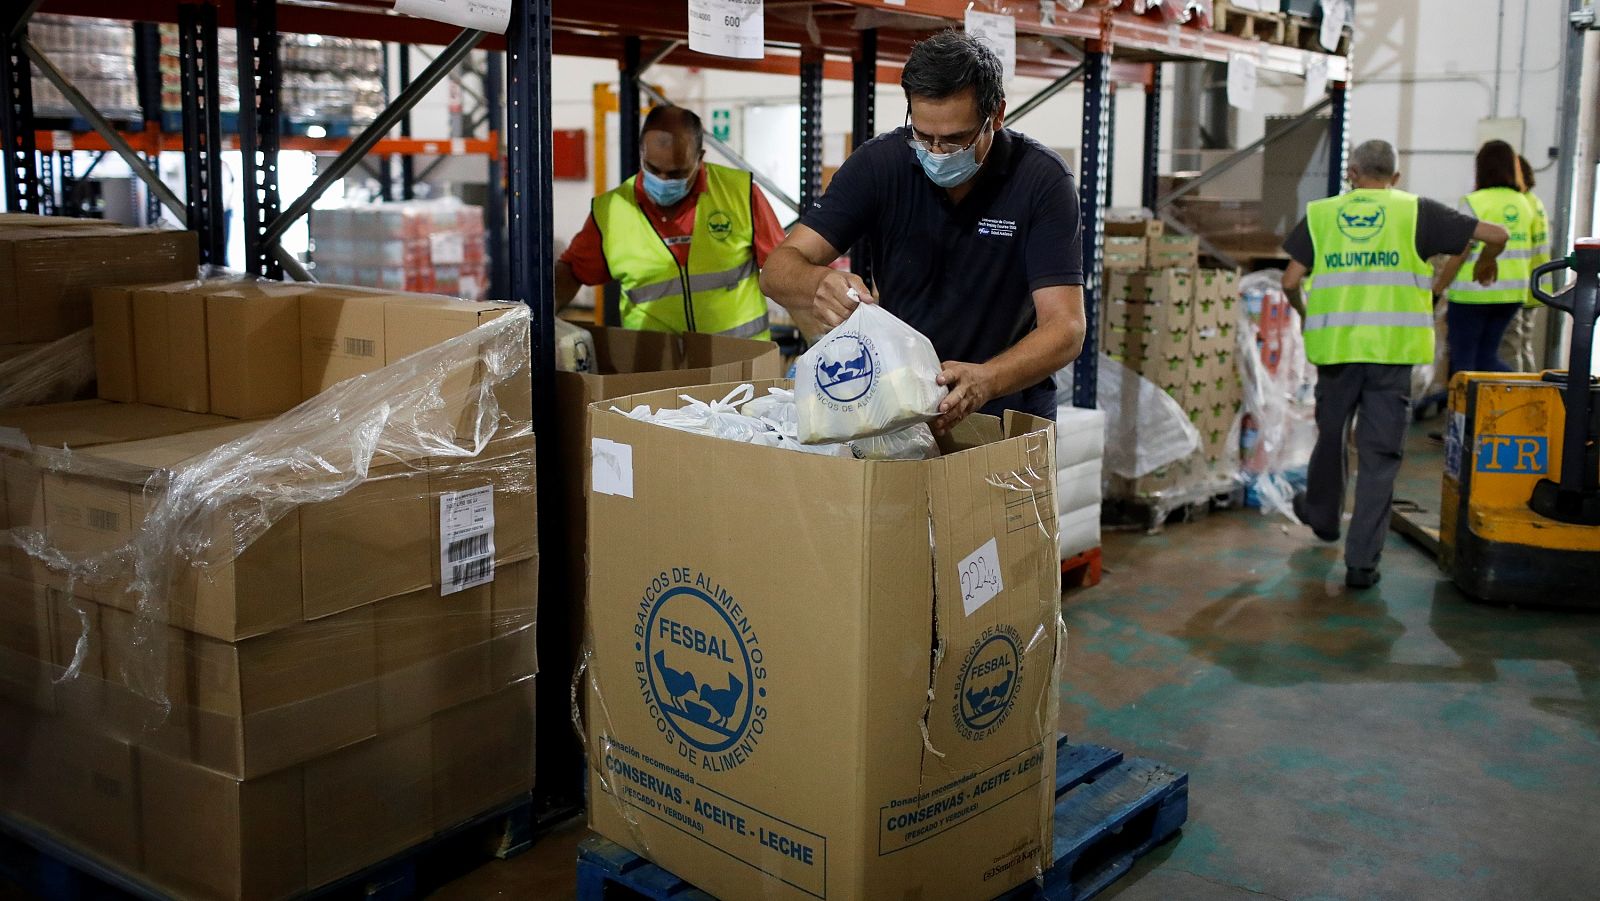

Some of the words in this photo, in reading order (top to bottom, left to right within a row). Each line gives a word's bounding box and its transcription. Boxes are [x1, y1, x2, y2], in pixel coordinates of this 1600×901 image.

[724, 15, 740, 28] 600
[1325, 251, 1399, 268] VOLUNTARIO
[842, 404, 854, 413] DE
[1481, 437, 1542, 471] TR
[635, 571, 670, 637] BANCOS
[672, 567, 691, 584] DE
[696, 572, 767, 680] ALIMENTOS
[659, 617, 734, 664] FESBAL
[954, 638, 981, 691] BANCOS
[982, 626, 994, 641] DE
[995, 623, 1025, 663] ALIMENTOS
[971, 653, 1011, 681] FESBAL
[635, 661, 675, 745] BANCOS
[678, 743, 697, 766] DE
[702, 705, 767, 773] ALIMENTOS
[952, 703, 973, 741] BANCOS
[973, 730, 985, 742] DE
[987, 676, 1024, 737] ALIMENTOS
[641, 752, 695, 785] recomendada
[931, 772, 977, 797] recomendada
[605, 754, 682, 805] CONSERVAS
[694, 798, 746, 837] ACEITE
[759, 827, 814, 866] LECHE
[656, 800, 663, 811] Y
[663, 806, 704, 834] VERDURAS)
[887, 792, 964, 832] CONSERVAS
[972, 768, 1010, 799] ACEITE
[904, 820, 938, 842] (PESCADO
